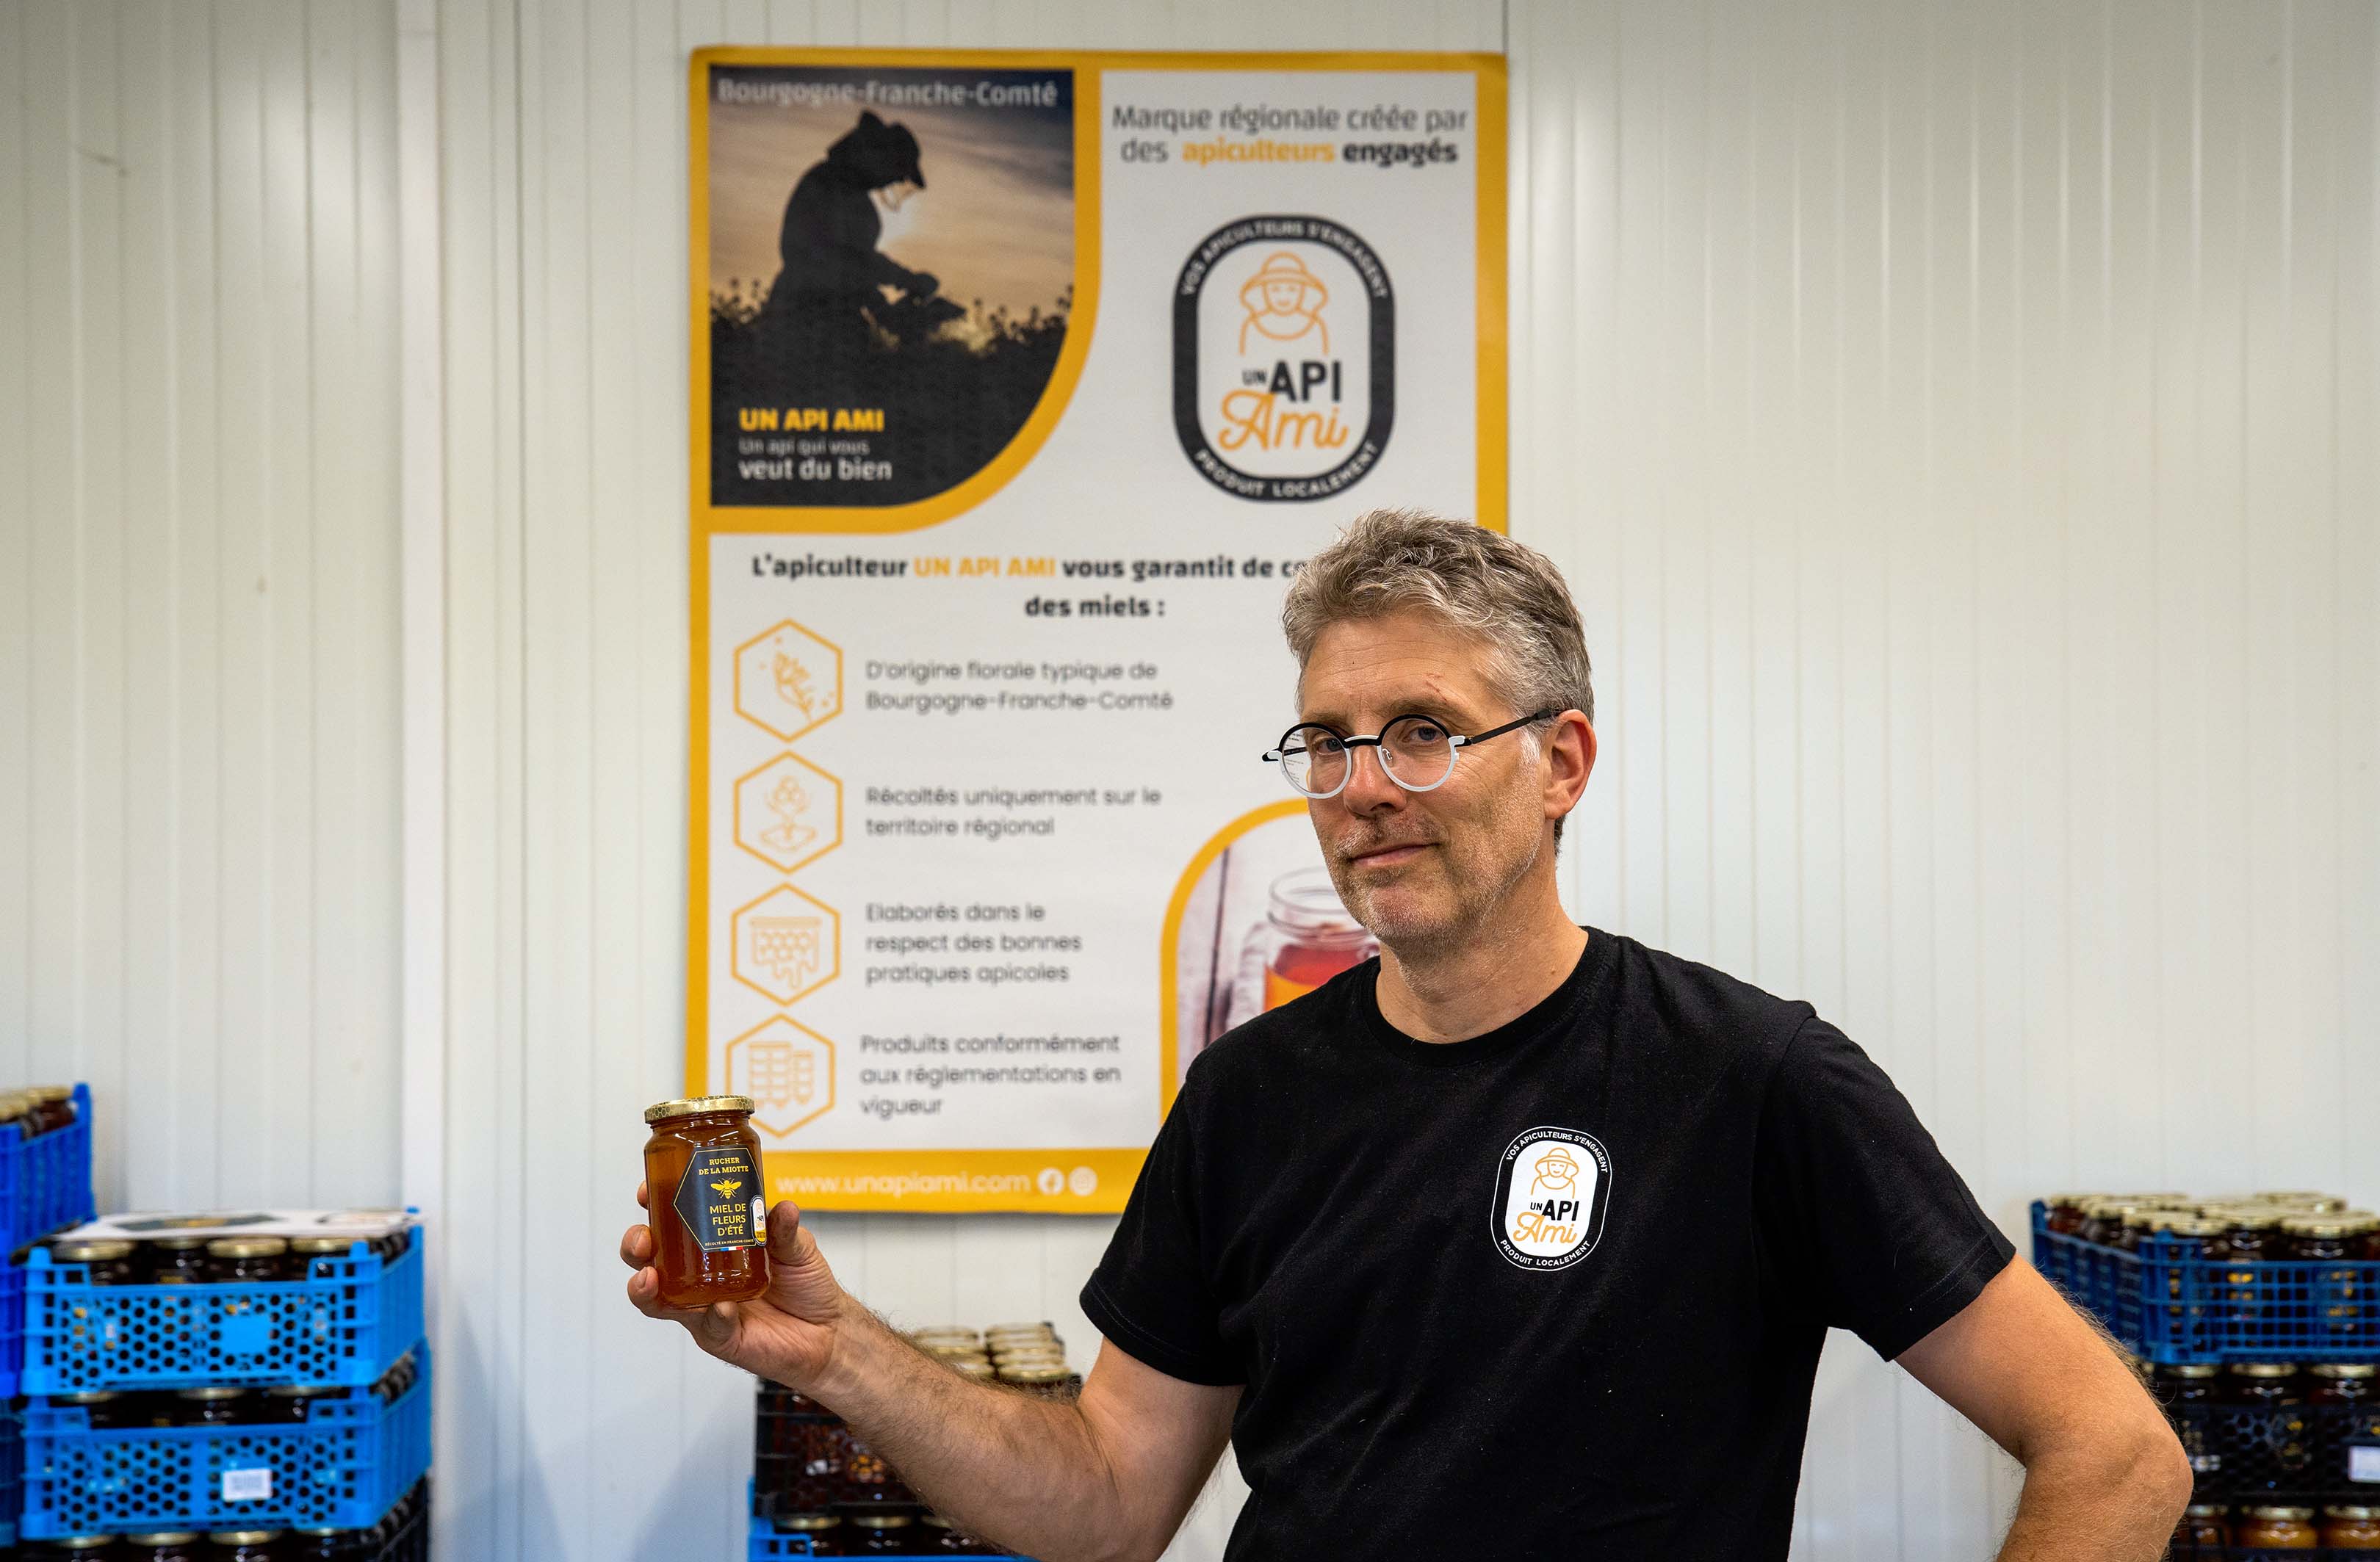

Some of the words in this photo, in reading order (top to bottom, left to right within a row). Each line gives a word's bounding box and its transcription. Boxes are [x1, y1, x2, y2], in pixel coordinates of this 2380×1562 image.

[718, 78, 1059, 108] Bourgogne-Franche-Comté
[1112, 104, 1214, 134] Marque
[1219, 104, 1341, 135] régionale
[1346, 104, 1419, 131] créée
[1425, 109, 1468, 134] par
[1120, 137, 1169, 163] des
[1181, 137, 1335, 167] apiculteurs
[1343, 137, 1459, 168] engagés
[1242, 371, 1267, 386] UN
[1269, 361, 1343, 402] API
[740, 407, 779, 432] UN
[784, 408, 829, 432] API
[832, 408, 885, 432] AMI
[1217, 390, 1349, 451] Ami
[738, 436, 765, 455] Un
[828, 439, 870, 455] vous
[738, 458, 793, 480] veut
[798, 456, 832, 480] du
[837, 456, 893, 481] bien
[1195, 449, 1266, 497] PRODUIT
[1272, 441, 1378, 498] LOCALEMENT
[752, 553, 908, 580] L'apiculteur
[914, 557, 951, 577] UN
[957, 557, 1001, 577] API
[1006, 558, 1056, 577] AMI
[1062, 560, 1125, 577] vous
[1132, 555, 1234, 582] garantit
[1241, 557, 1273, 578] de
[1025, 596, 1072, 617] des
[1079, 594, 1150, 618] miels
[867, 661, 962, 684] D'origine
[1041, 662, 1125, 684] typique
[1128, 662, 1158, 680] de
[867, 690, 1173, 715] Bourgogne-Franche-Comté
[866, 787, 958, 806] Récoltés
[963, 786, 1097, 810] uniquement
[1103, 790, 1136, 806] sur
[1142, 787, 1161, 806] le
[866, 817, 957, 836] territoire
[964, 816, 1055, 841] régional
[964, 903, 1020, 922] dans
[1026, 903, 1045, 922] le
[866, 933, 948, 956] respect
[954, 932, 994, 952] des
[1000, 933, 1083, 952] bonnes
[866, 963, 970, 987] pratiques
[976, 962, 1070, 987] apicoles
[860, 1035, 949, 1053] Produits
[955, 1033, 1120, 1053] conformément
[860, 1069, 900, 1084] aux
[1092, 1068, 1122, 1083] en
[860, 1096, 942, 1121] vigueur
[709, 1157, 740, 1165] RUCHER
[1506, 1144, 1520, 1161] VOS
[1519, 1131, 1573, 1146] APICULTEURS
[1573, 1135, 1609, 1174] S'ENGAGENT
[775, 1171, 1029, 1197] www.unapiami.com
[710, 1204, 732, 1214] MIEL
[735, 1203, 746, 1212] DE
[713, 1215, 746, 1225] FLEURS
[1530, 1201, 1543, 1211] UN
[1542, 1199, 1579, 1221] API
[717, 1224, 744, 1236] D'ÉTÉ
[1512, 1212, 1578, 1243] Ami
[1500, 1239, 1532, 1265] PRODUIT
[1536, 1240, 1590, 1266] LOCALEMENT
